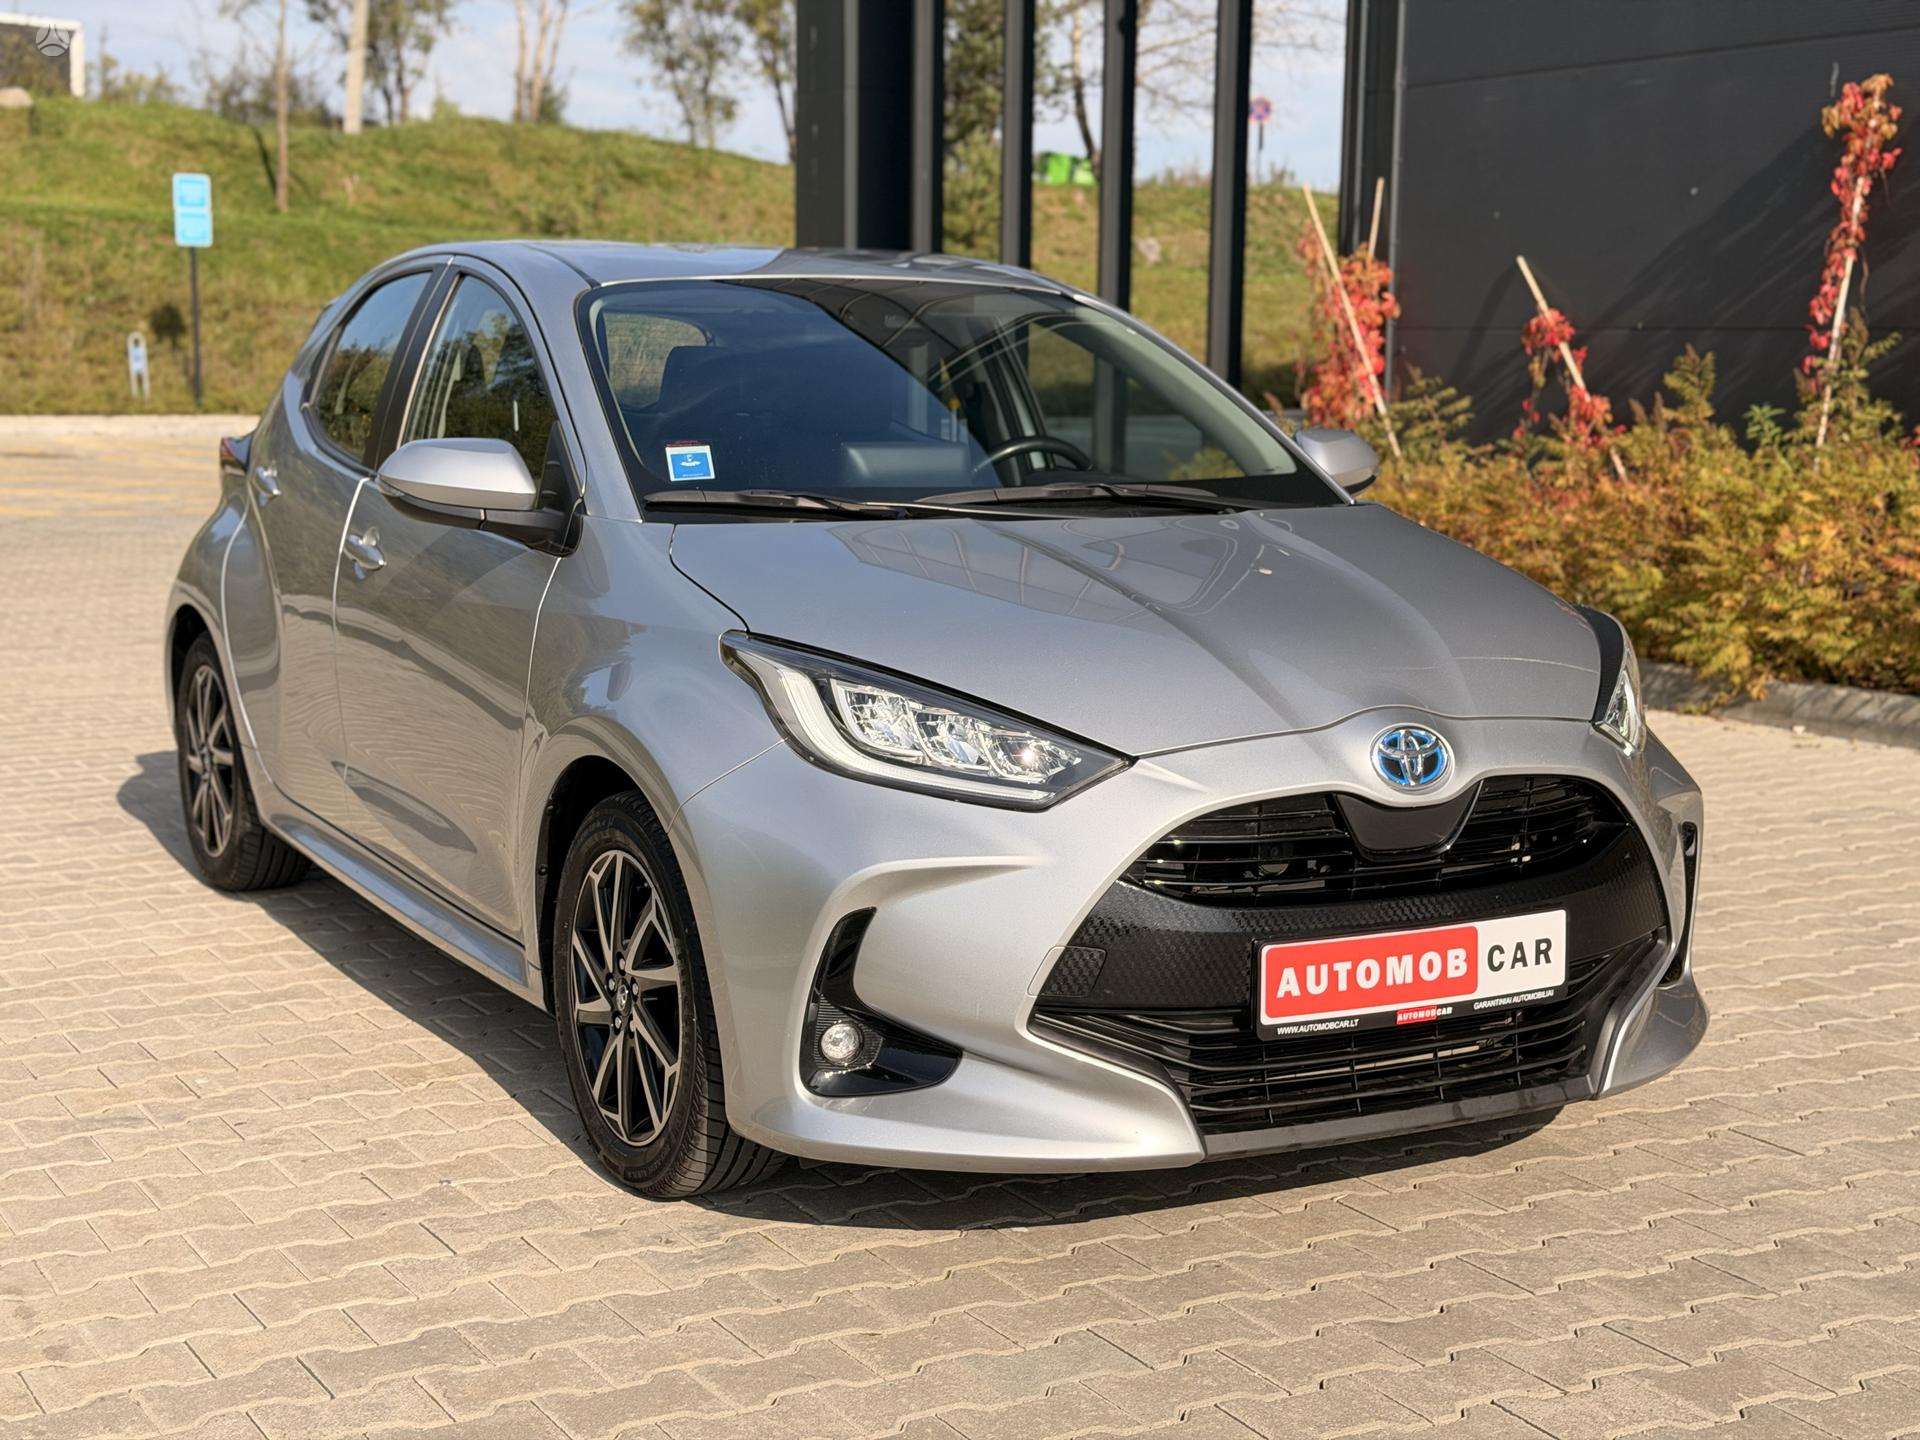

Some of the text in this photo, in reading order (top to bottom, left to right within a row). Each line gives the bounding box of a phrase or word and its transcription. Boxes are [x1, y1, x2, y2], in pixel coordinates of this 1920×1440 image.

[1276, 937, 1552, 999] AUTOMOB CAR
[1277, 1018, 1360, 1035] WWW.AUTOMOBCAR.LT
